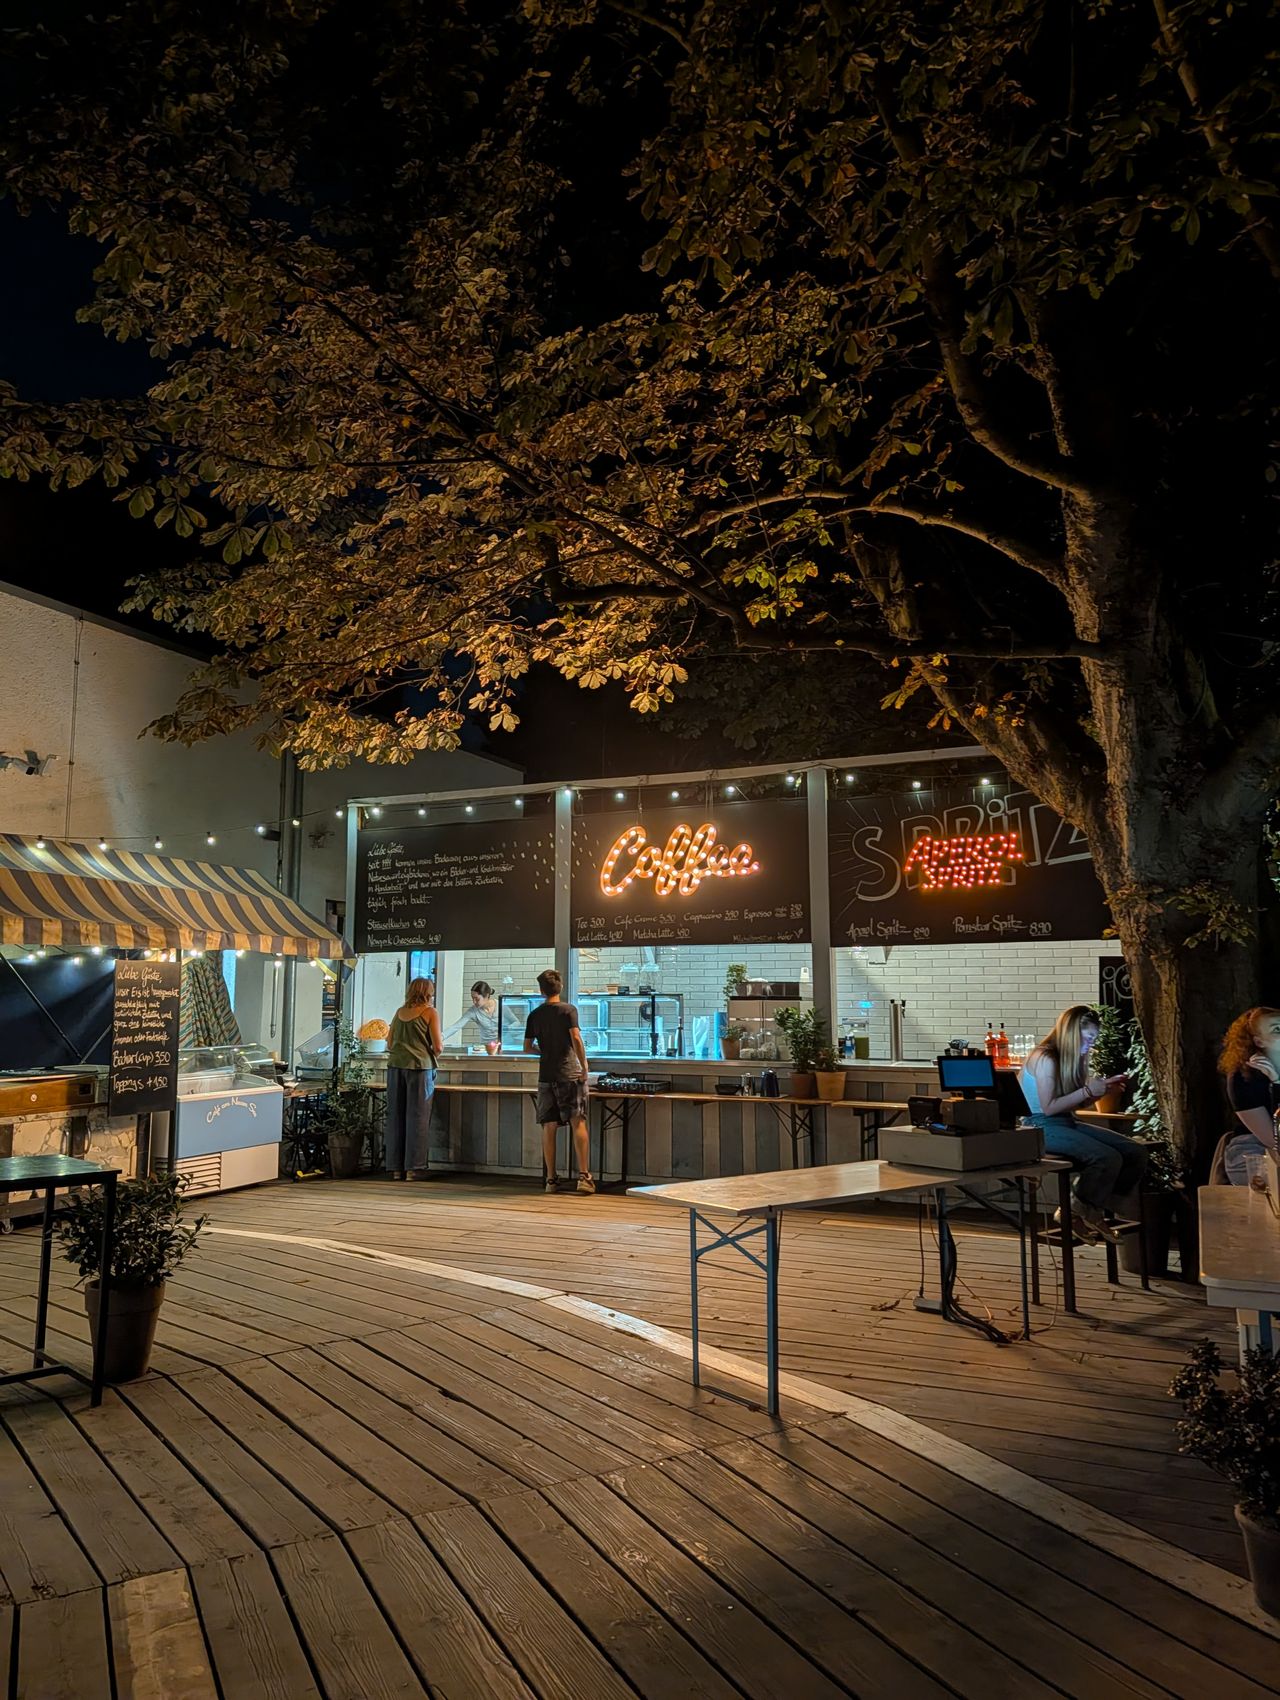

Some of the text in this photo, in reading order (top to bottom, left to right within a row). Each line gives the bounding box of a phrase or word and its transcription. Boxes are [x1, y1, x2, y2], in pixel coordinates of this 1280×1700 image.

[367, 842, 387, 857] Liebe
[904, 832, 1023, 872] APEROL
[600, 823, 761, 896] Coffee
[921, 861, 1002, 890] SPRITZ
[743, 908, 773, 923] Espresso
[590, 930, 609, 941] Latte
[632, 928, 658, 940] Matcha
[657, 927, 675, 939] Latte
[117, 964, 139, 980] Liebe
[131, 986, 142, 998] Eis
[110, 1073, 145, 1094] Toppings
[206, 1104, 221, 1123] Café
